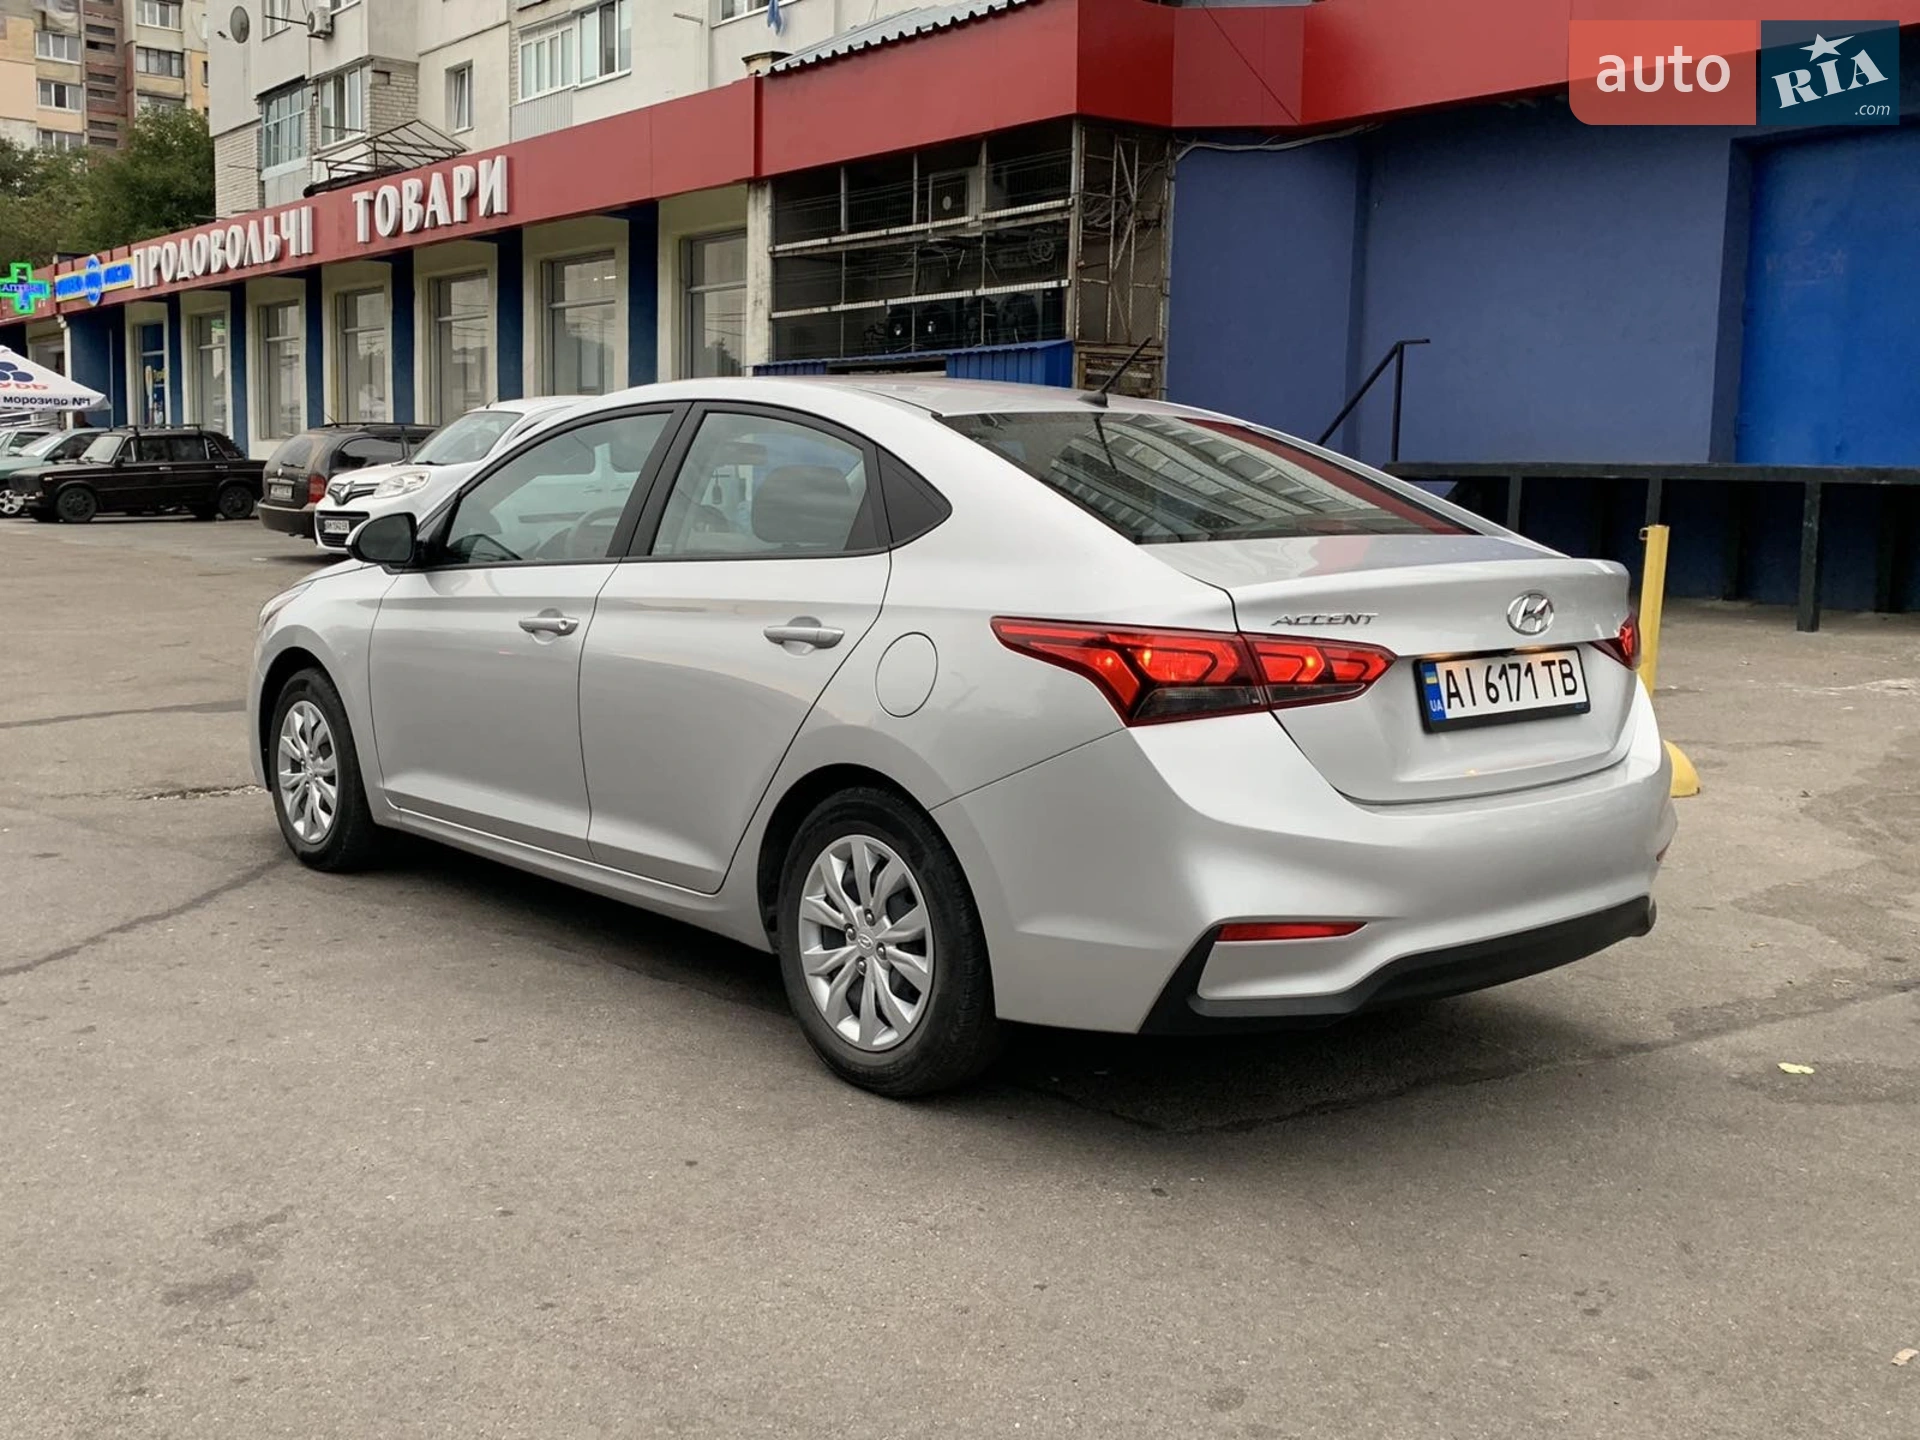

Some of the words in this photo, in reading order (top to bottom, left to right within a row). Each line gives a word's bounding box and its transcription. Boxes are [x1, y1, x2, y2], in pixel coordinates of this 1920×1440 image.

[133, 206, 313, 289] ПРОДОВОЛЬЧІ
[352, 155, 508, 243] ТОВАРИ
[1271, 612, 1379, 626] ACCENT
[1445, 667, 1477, 709] AI
[1484, 662, 1539, 704] 6171
[1541, 659, 1578, 698] TB
[1430, 699, 1443, 712] UA
